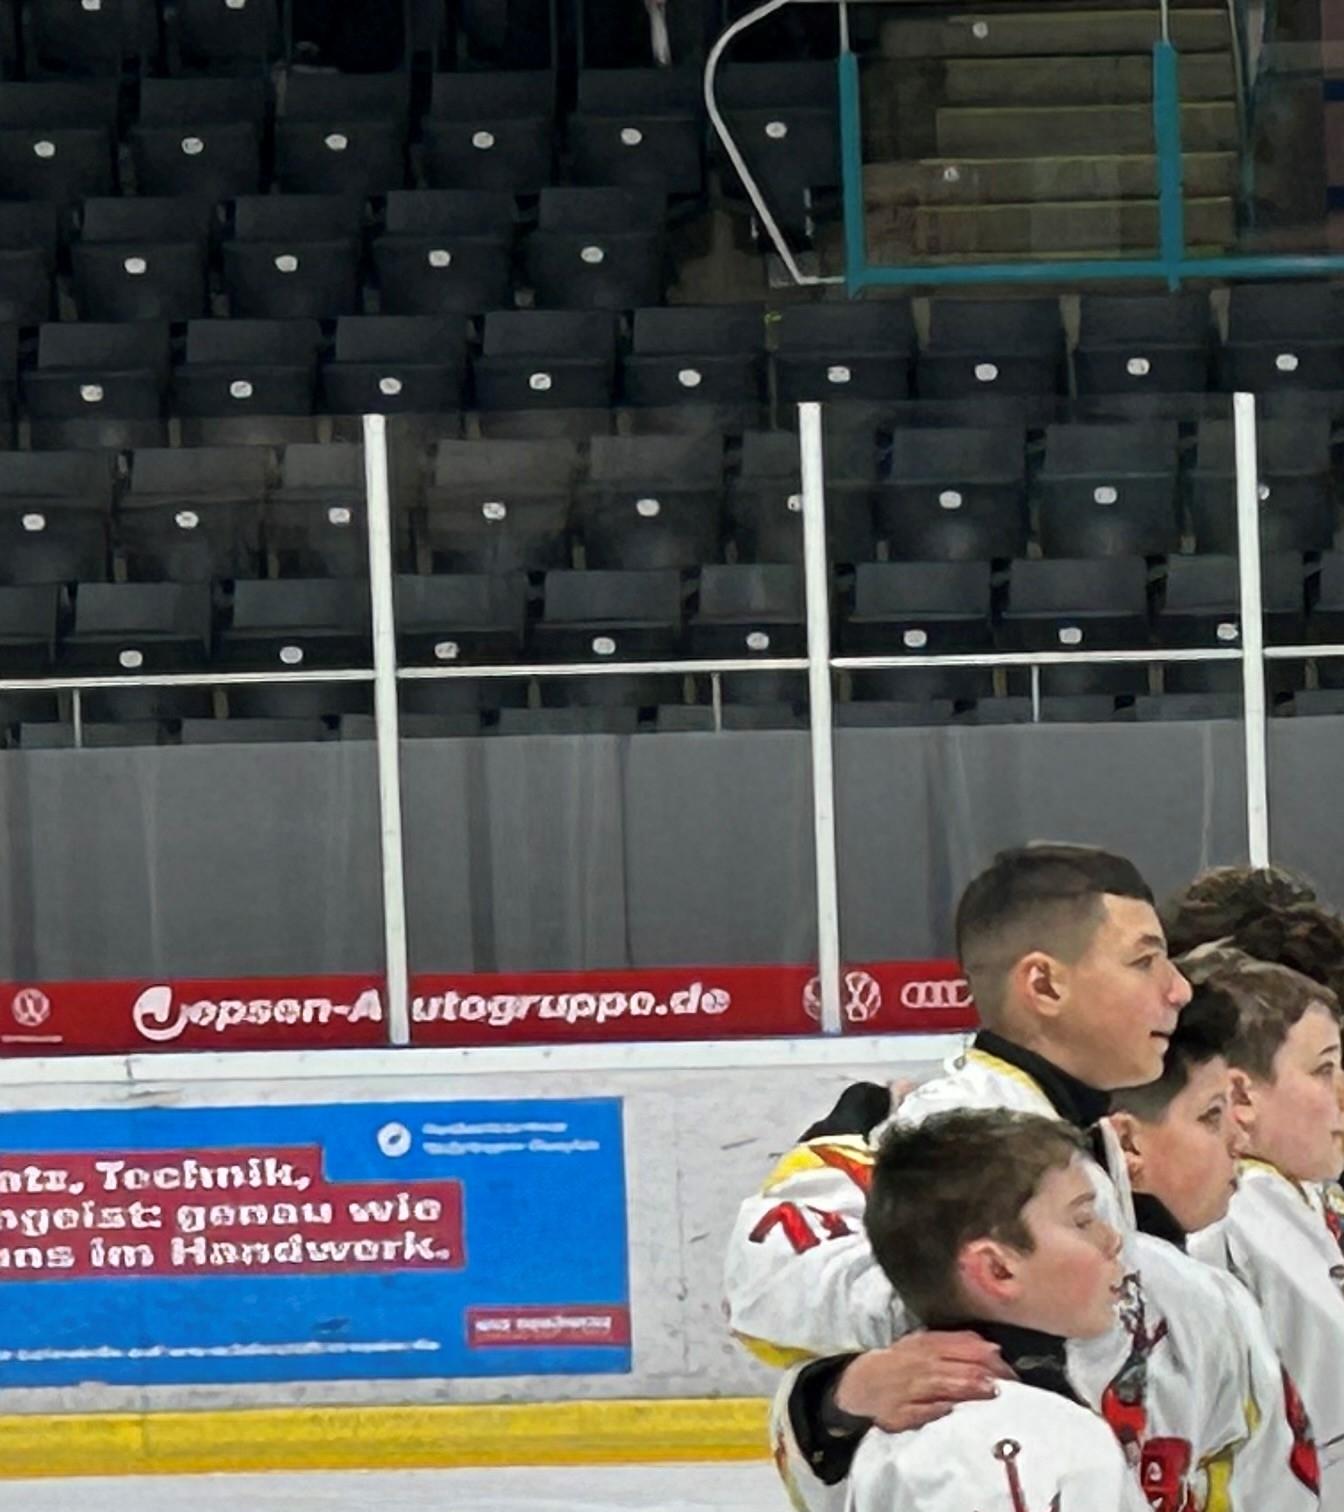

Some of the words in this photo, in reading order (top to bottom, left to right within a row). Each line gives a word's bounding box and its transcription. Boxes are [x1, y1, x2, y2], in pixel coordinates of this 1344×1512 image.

[95, 1157, 312, 1192] Technik,
[177, 1201, 332, 1233] genau
[349, 1192, 441, 1223] wie
[90, 1236, 155, 1267] im
[170, 1231, 451, 1267] Handwerk.
